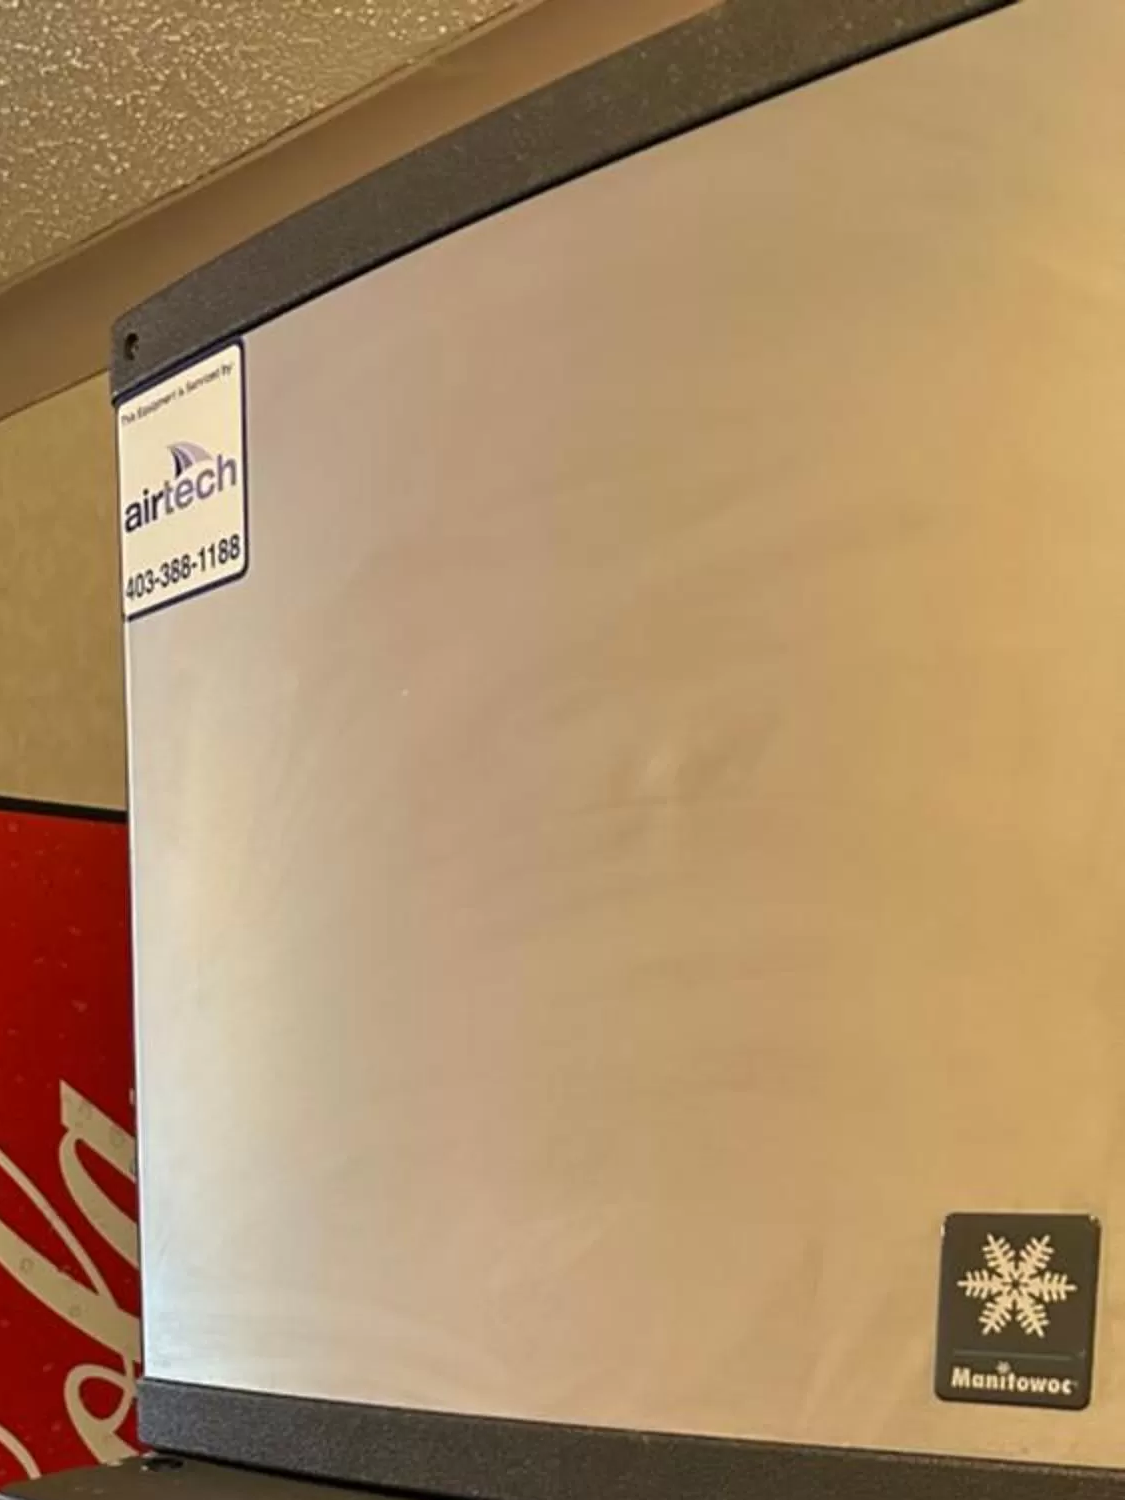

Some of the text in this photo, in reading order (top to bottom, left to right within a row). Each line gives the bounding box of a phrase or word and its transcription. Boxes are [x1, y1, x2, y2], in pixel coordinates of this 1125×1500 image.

[124, 453, 237, 533] airtech
[125, 534, 240, 601] 403-388-1188
[950, 1363, 1073, 1395] Manitowoc
